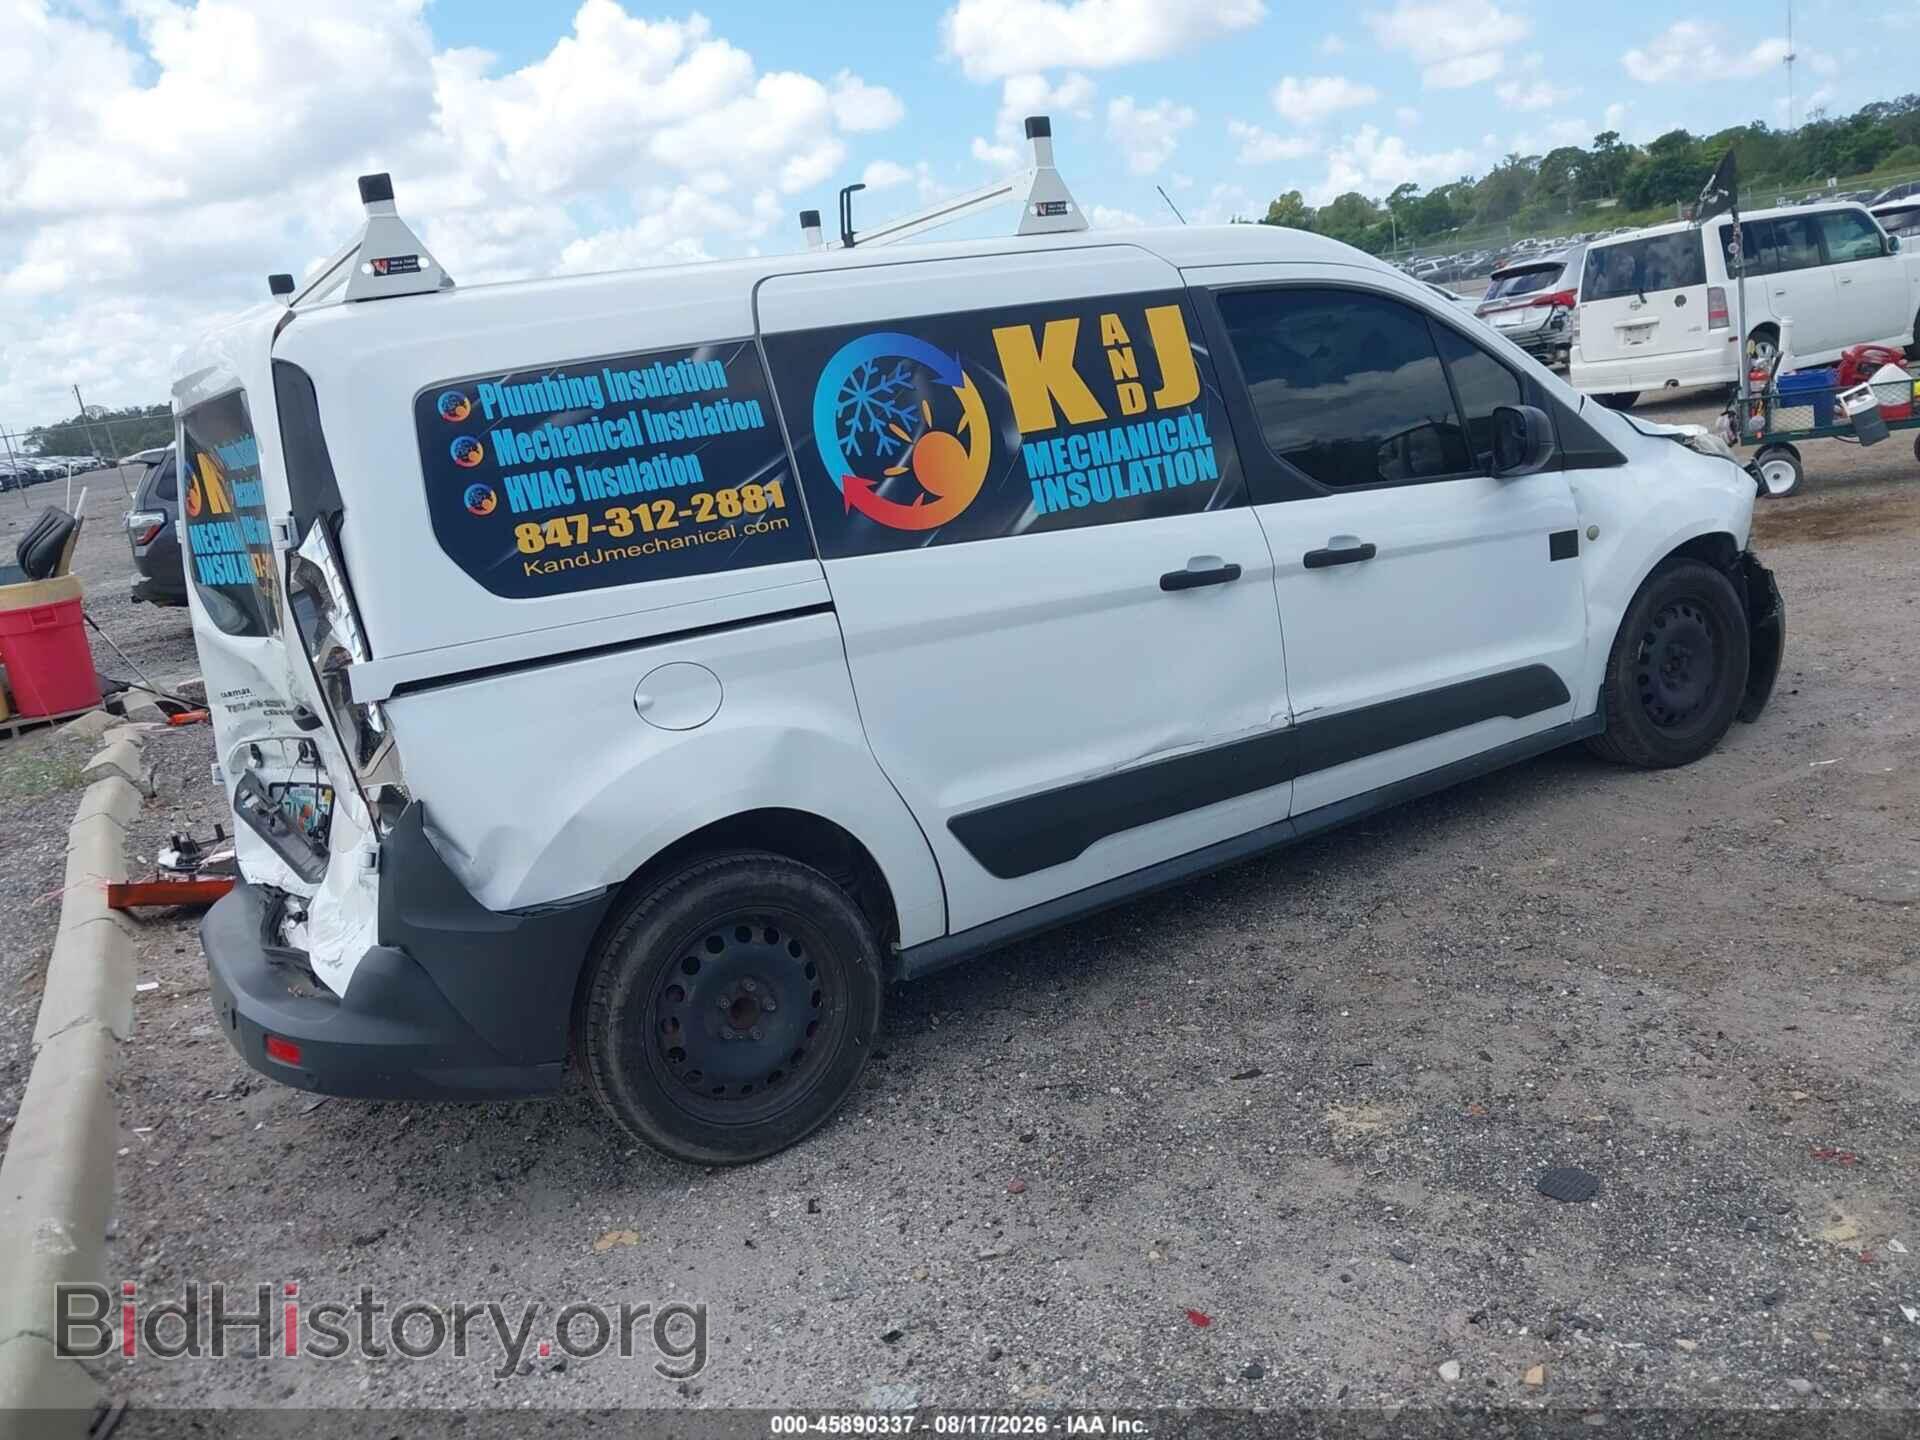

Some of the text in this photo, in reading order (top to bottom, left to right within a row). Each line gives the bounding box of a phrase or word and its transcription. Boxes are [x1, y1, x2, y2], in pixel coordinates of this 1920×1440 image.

[478, 358, 728, 420] Plumbing Insulation
[991, 303, 1201, 434] K AND J
[490, 398, 765, 467] Mechanical Insulation
[1022, 412, 1213, 479] MECHANICAL
[503, 452, 704, 514] HVAC Insulation
[1030, 446, 1219, 516] INSULATION
[514, 480, 786, 555] 847-312-2881
[523, 516, 790, 577] KandJmechanical.com
